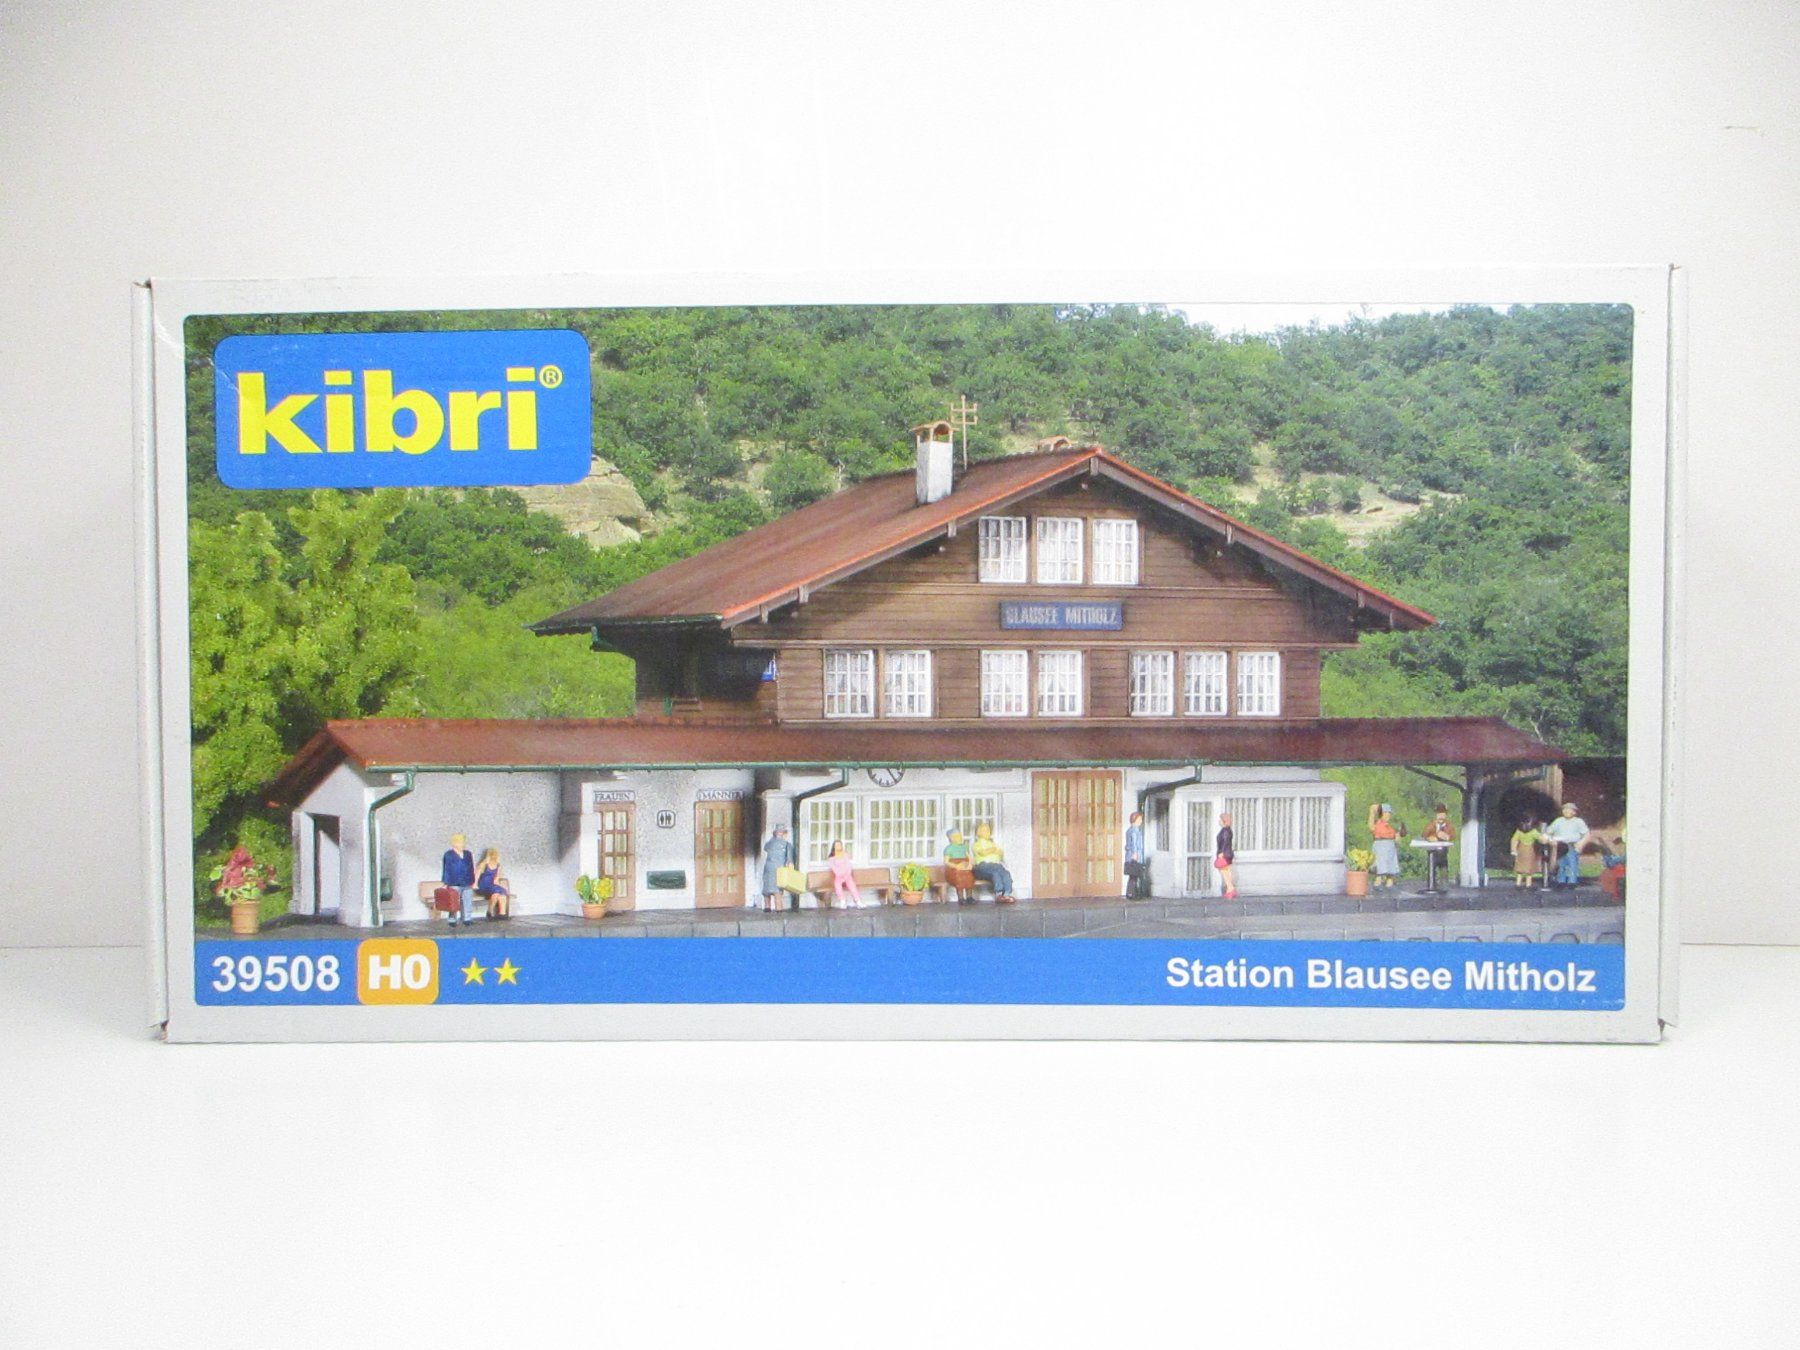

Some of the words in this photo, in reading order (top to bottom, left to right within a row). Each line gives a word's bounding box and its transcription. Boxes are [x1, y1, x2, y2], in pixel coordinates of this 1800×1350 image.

[211, 954, 341, 992] 39508
[1166, 957, 1294, 988] Station
[1307, 959, 1453, 990] Blausee
[1464, 960, 1597, 992] Mitholz
